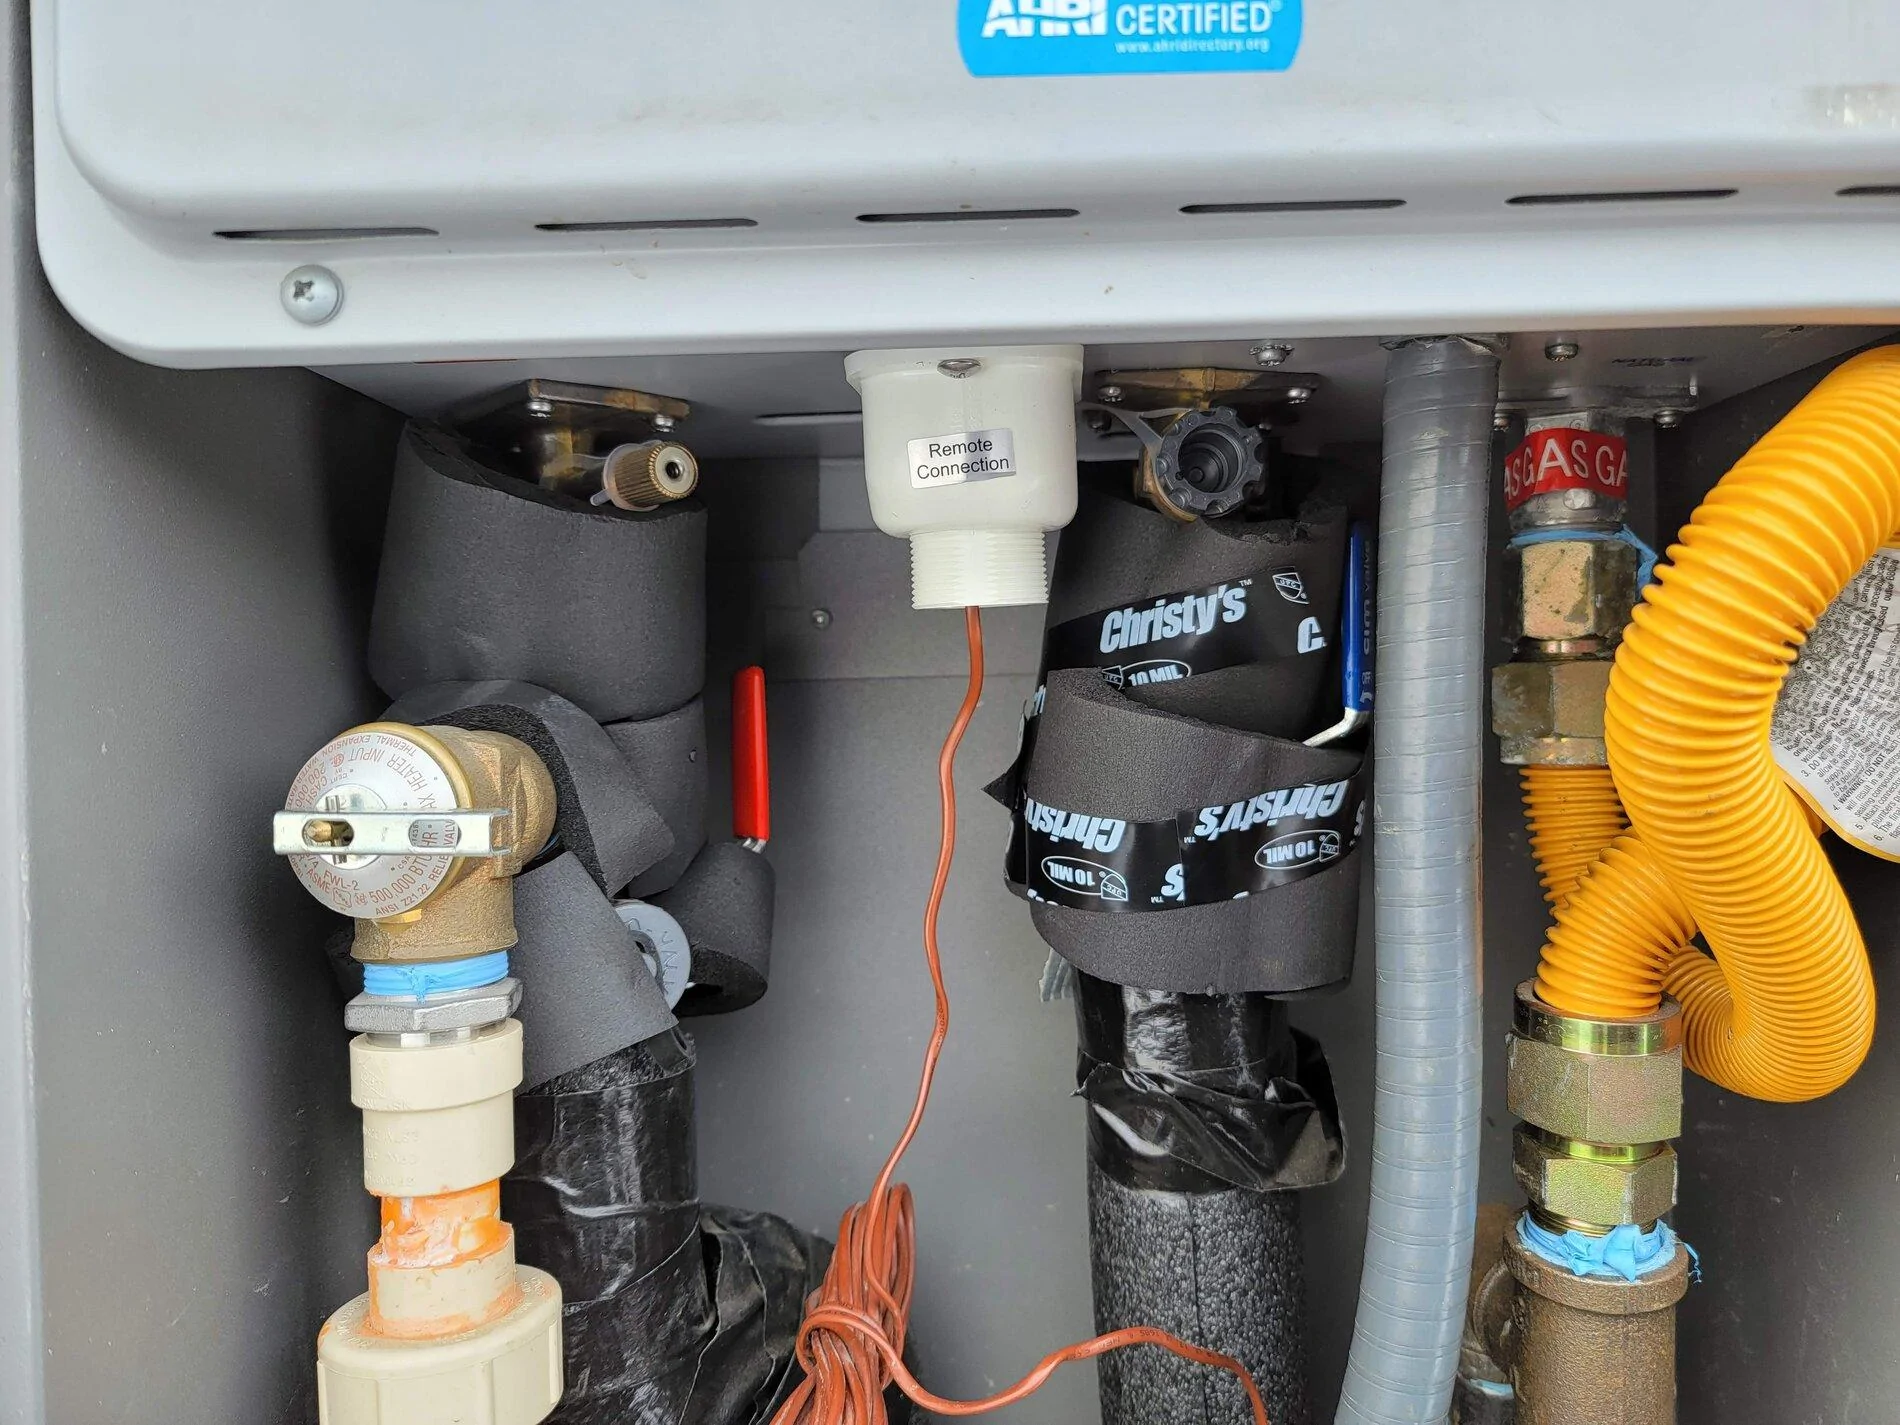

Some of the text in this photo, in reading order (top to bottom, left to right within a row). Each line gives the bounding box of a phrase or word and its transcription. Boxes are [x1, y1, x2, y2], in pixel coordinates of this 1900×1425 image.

[1113, 38, 1270, 54] www.ahridirectory.org
[928, 438, 993, 458] Remote
[916, 456, 1009, 480] Connection
[1099, 584, 1247, 654] Christy's
[320, 735, 371, 758] EXPANSION
[348, 747, 386, 763] INPUT
[376, 735, 418, 757] THERMAL
[386, 753, 427, 792] HEATER
[1864, 765, 1875, 776] DO
[1872, 753, 1885, 767] NOT
[1845, 799, 1856, 810] will
[1869, 777, 1877, 785] in
[1876, 770, 1884, 778] an
[1854, 795, 1874, 818] sealing
[1862, 803, 1879, 821] Attach
[1263, 843, 1296, 865] MIL
[1296, 839, 1316, 859] 10
[306, 867, 331, 895] ASME
[323, 870, 359, 892] FWL-2
[1046, 861, 1076, 884] MIL
[1075, 869, 1096, 887] 10
[375, 903, 400, 917] ANSI
[403, 883, 431, 907] Z21.22
